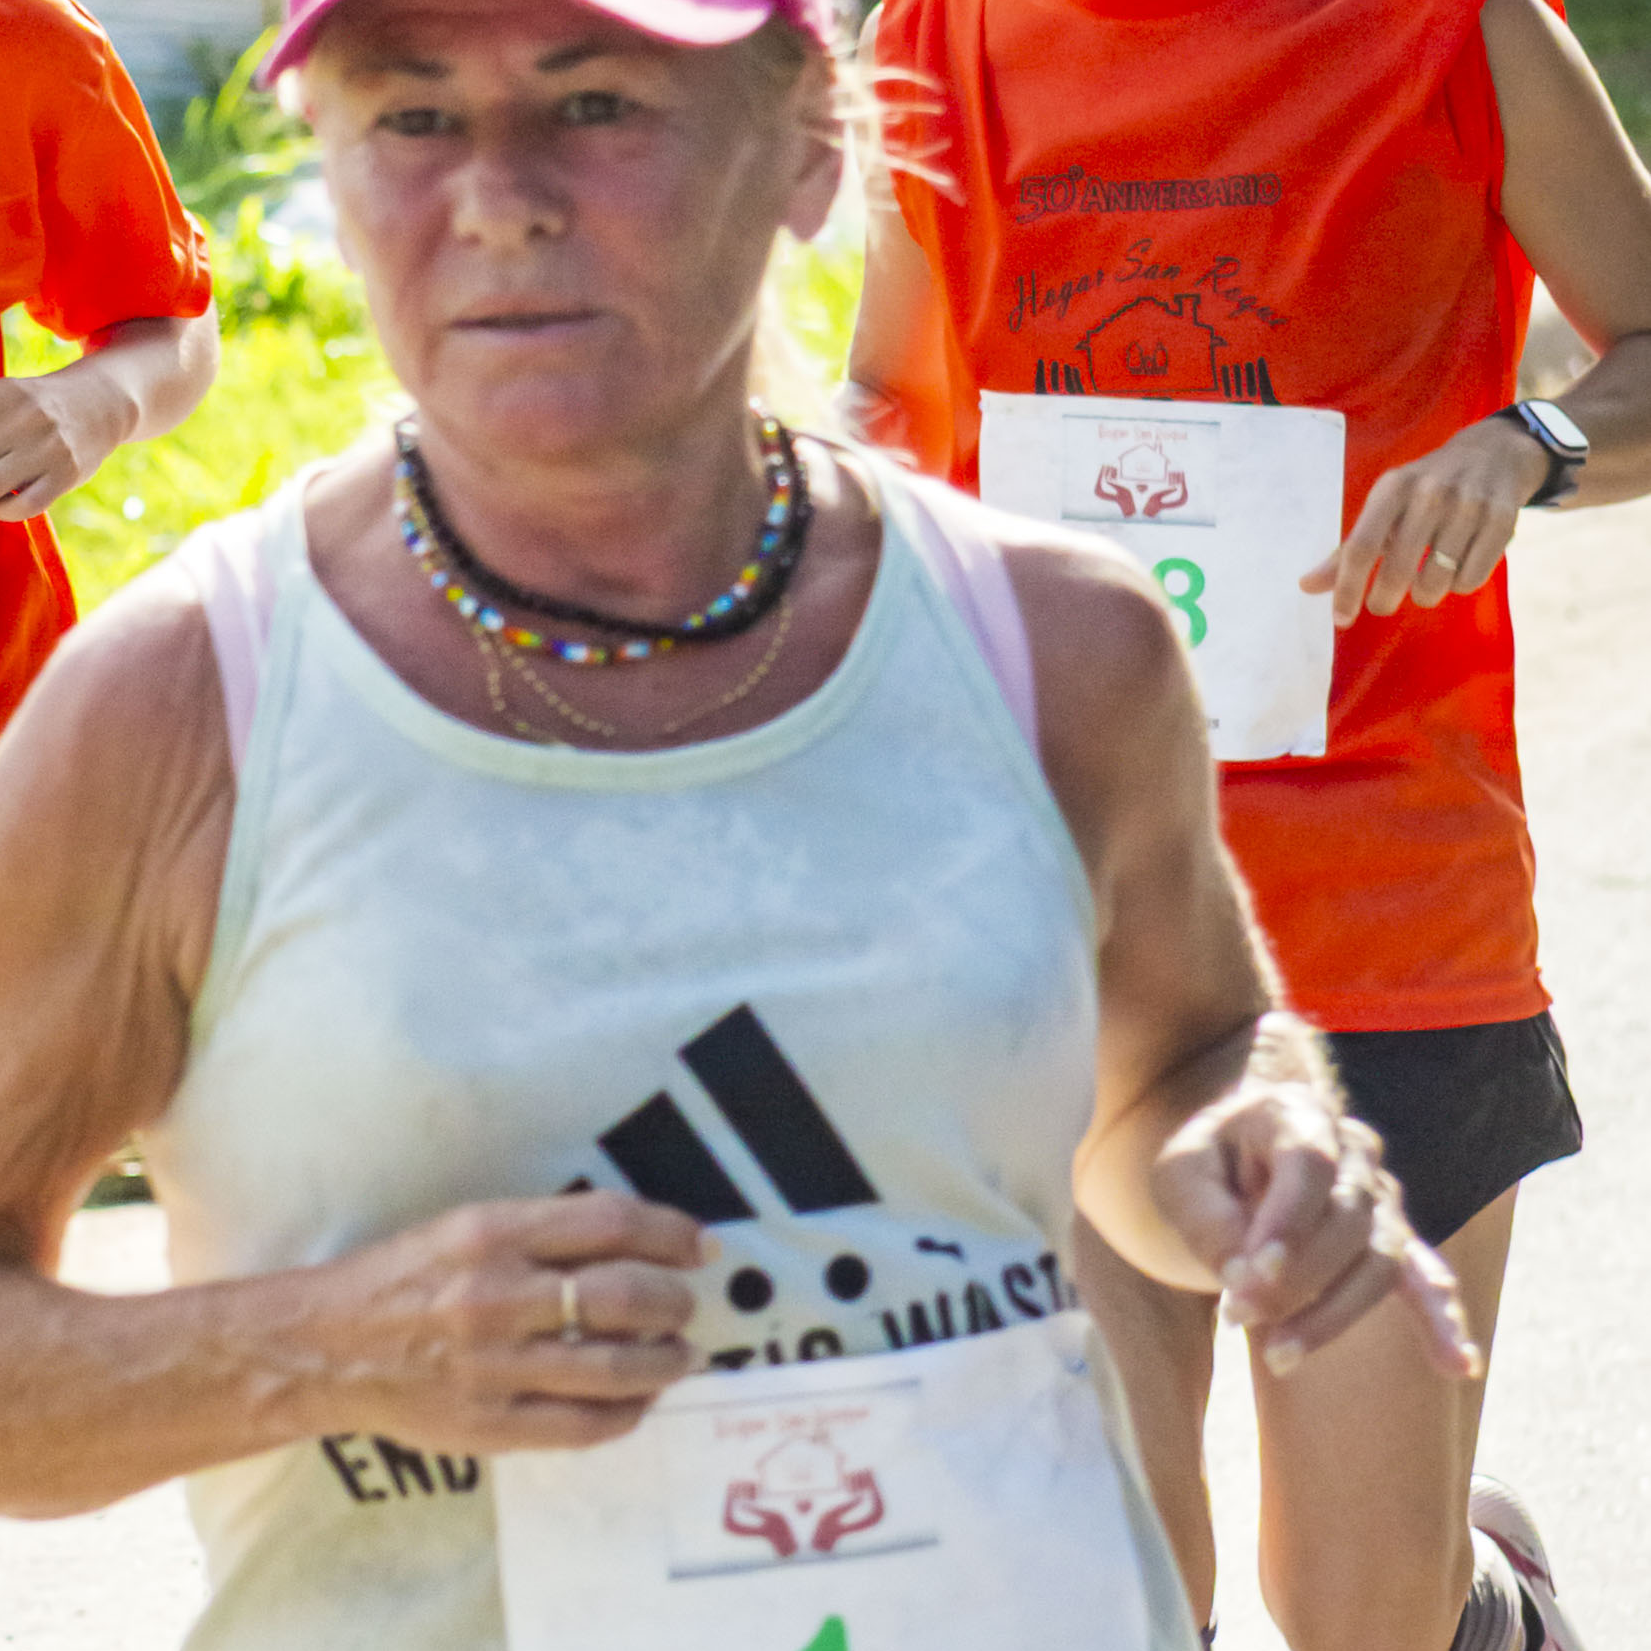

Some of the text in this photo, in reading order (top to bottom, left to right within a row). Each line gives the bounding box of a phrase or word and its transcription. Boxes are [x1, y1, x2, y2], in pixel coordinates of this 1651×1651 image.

[1008, 269, 1103, 332] Hogar
[1115, 238, 1181, 282] San
[880, 1252, 1078, 1350] WAST
